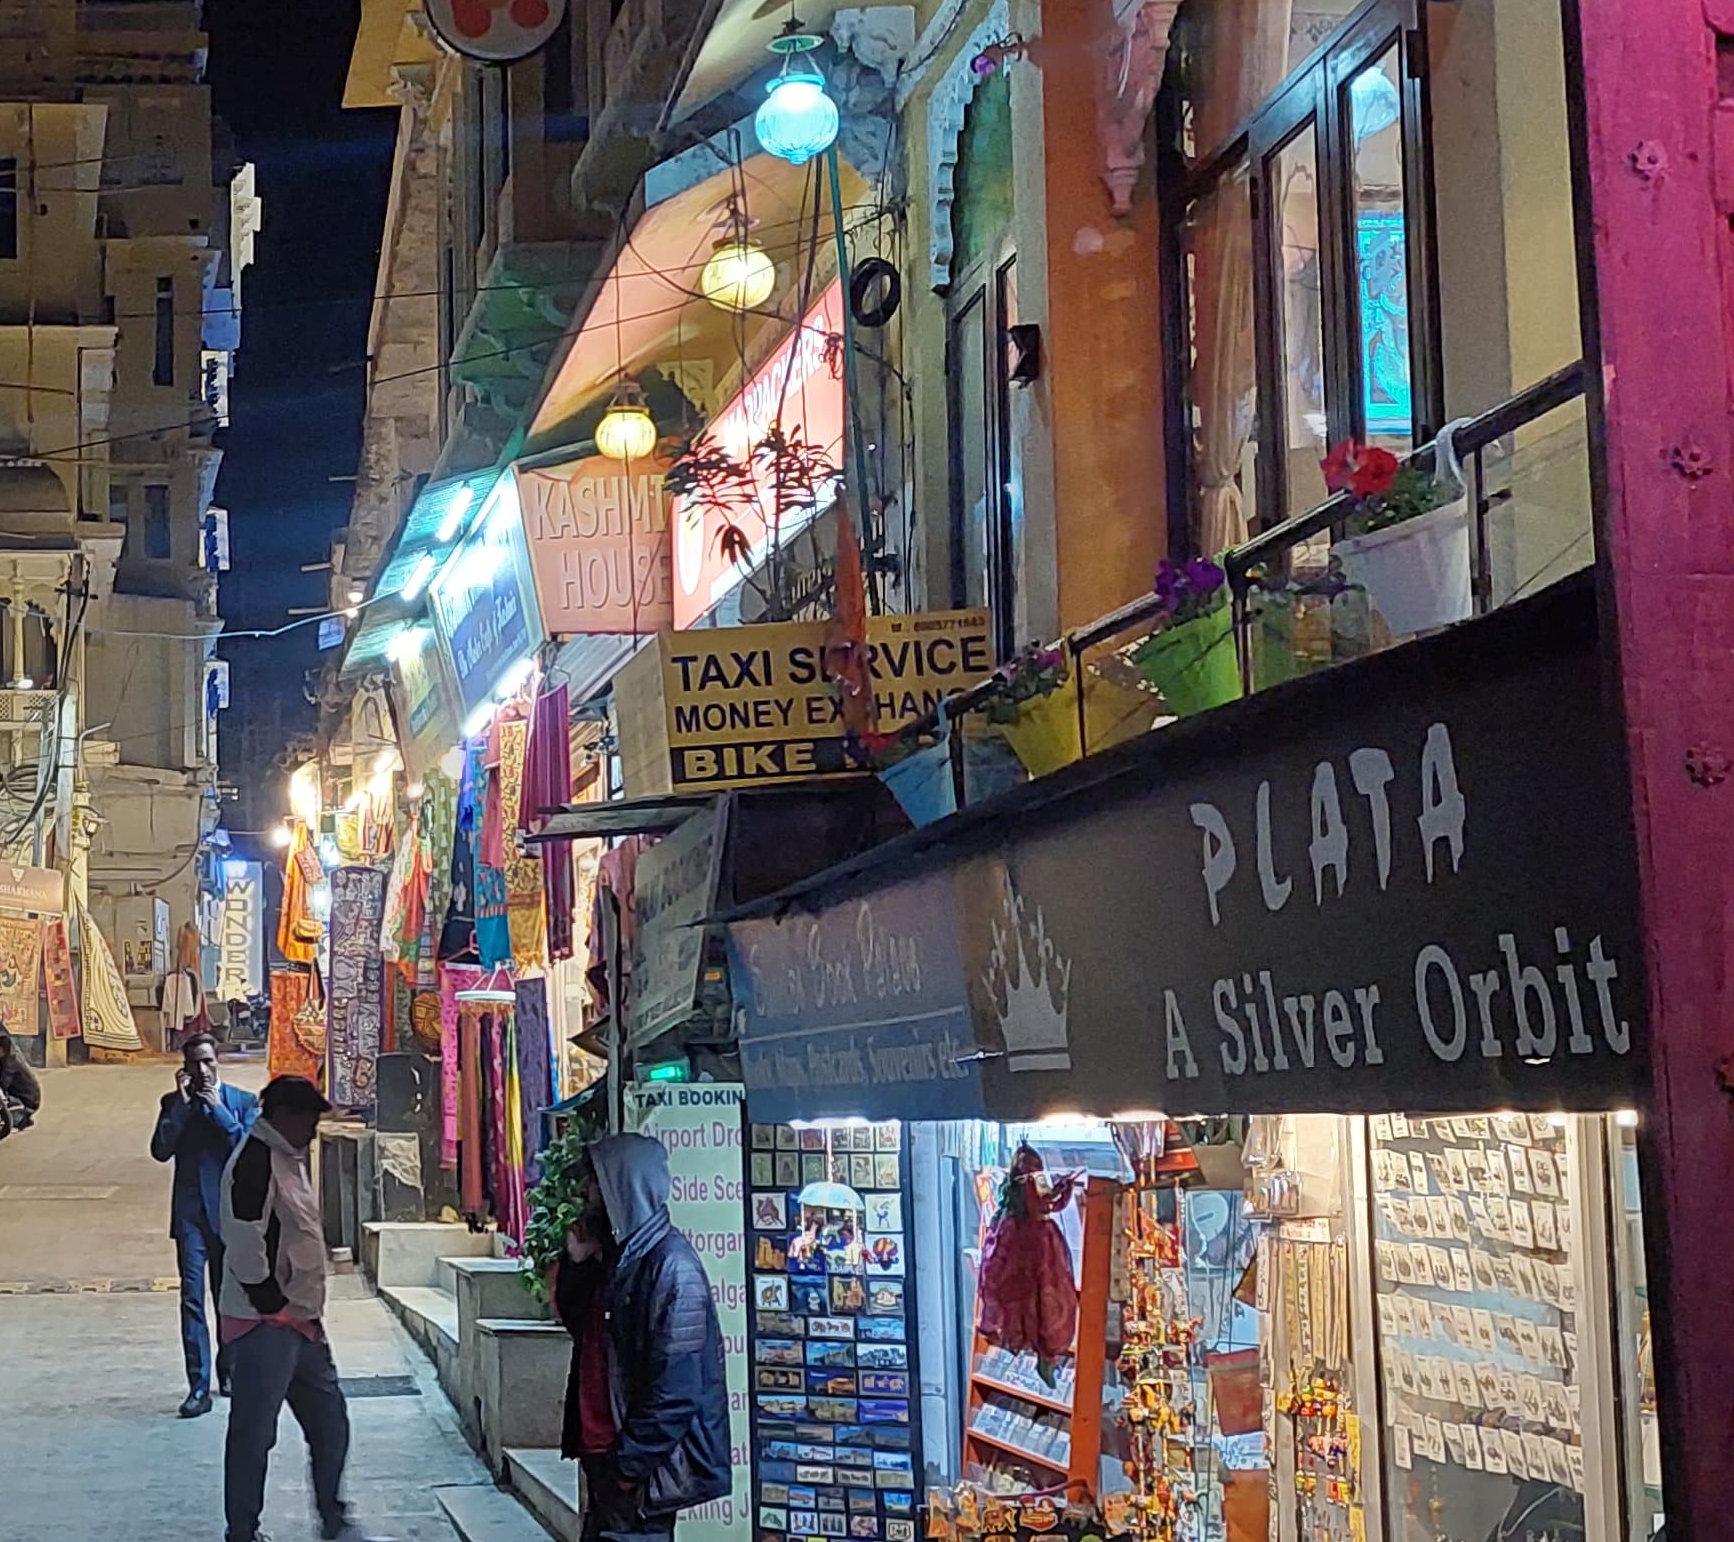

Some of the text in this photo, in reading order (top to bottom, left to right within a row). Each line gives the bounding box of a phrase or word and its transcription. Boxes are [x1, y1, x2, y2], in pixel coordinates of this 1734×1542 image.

[562, 545, 672, 609] HOUSE
[671, 650, 772, 692] TAXI
[675, 687, 968, 734] MONEY EXHAN
[683, 743, 817, 779] BIKE
[1189, 722, 1466, 926] PLATA
[1164, 926, 1630, 1080] A Silver Orbit
[635, 1090, 744, 1109] TAXI BOOKIN
[713, 1121, 742, 1147] Dro
[671, 1175, 743, 1202] Side Sce
